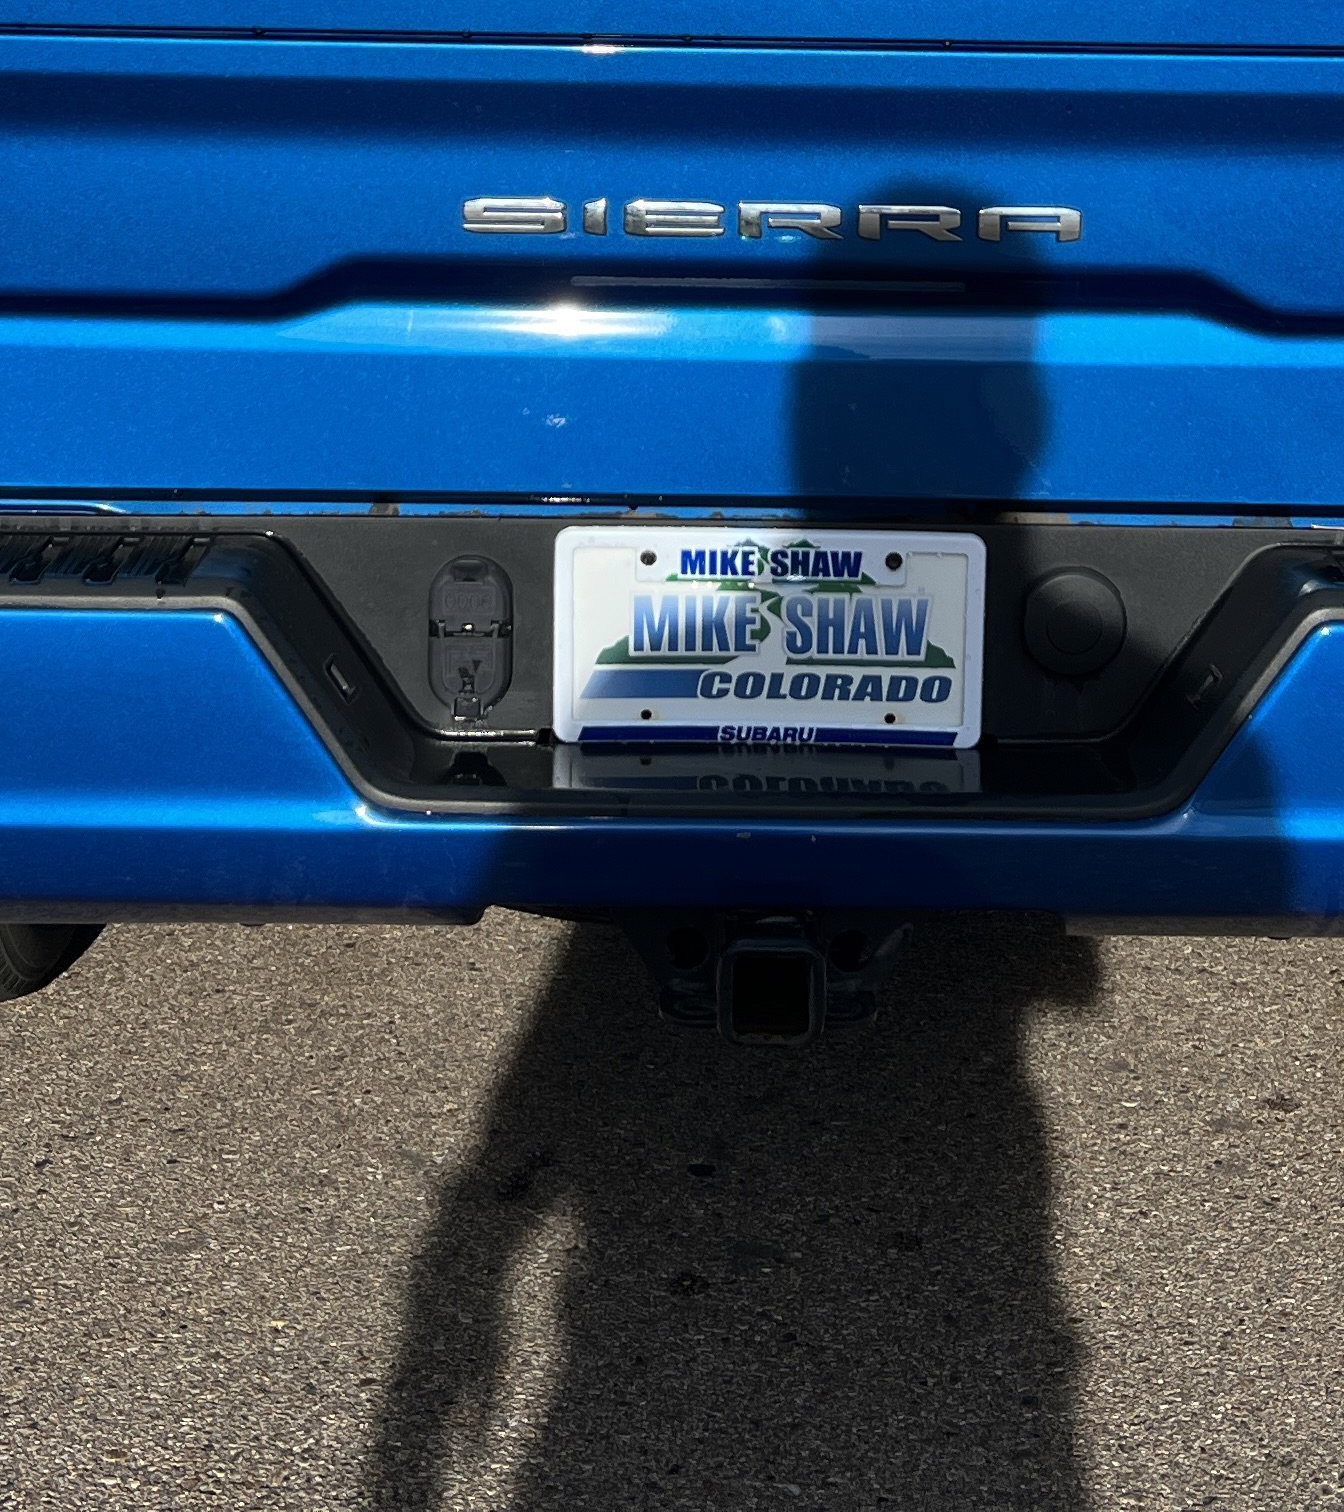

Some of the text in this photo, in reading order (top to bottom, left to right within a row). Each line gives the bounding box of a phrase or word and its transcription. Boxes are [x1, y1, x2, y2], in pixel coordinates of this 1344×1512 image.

[461, 194, 1084, 244] SIERRA
[680, 549, 862, 578] MIKE SHAW
[632, 593, 929, 657] MIKE SHAW
[698, 670, 953, 704] COLORADO
[718, 724, 816, 743] SUBARU
